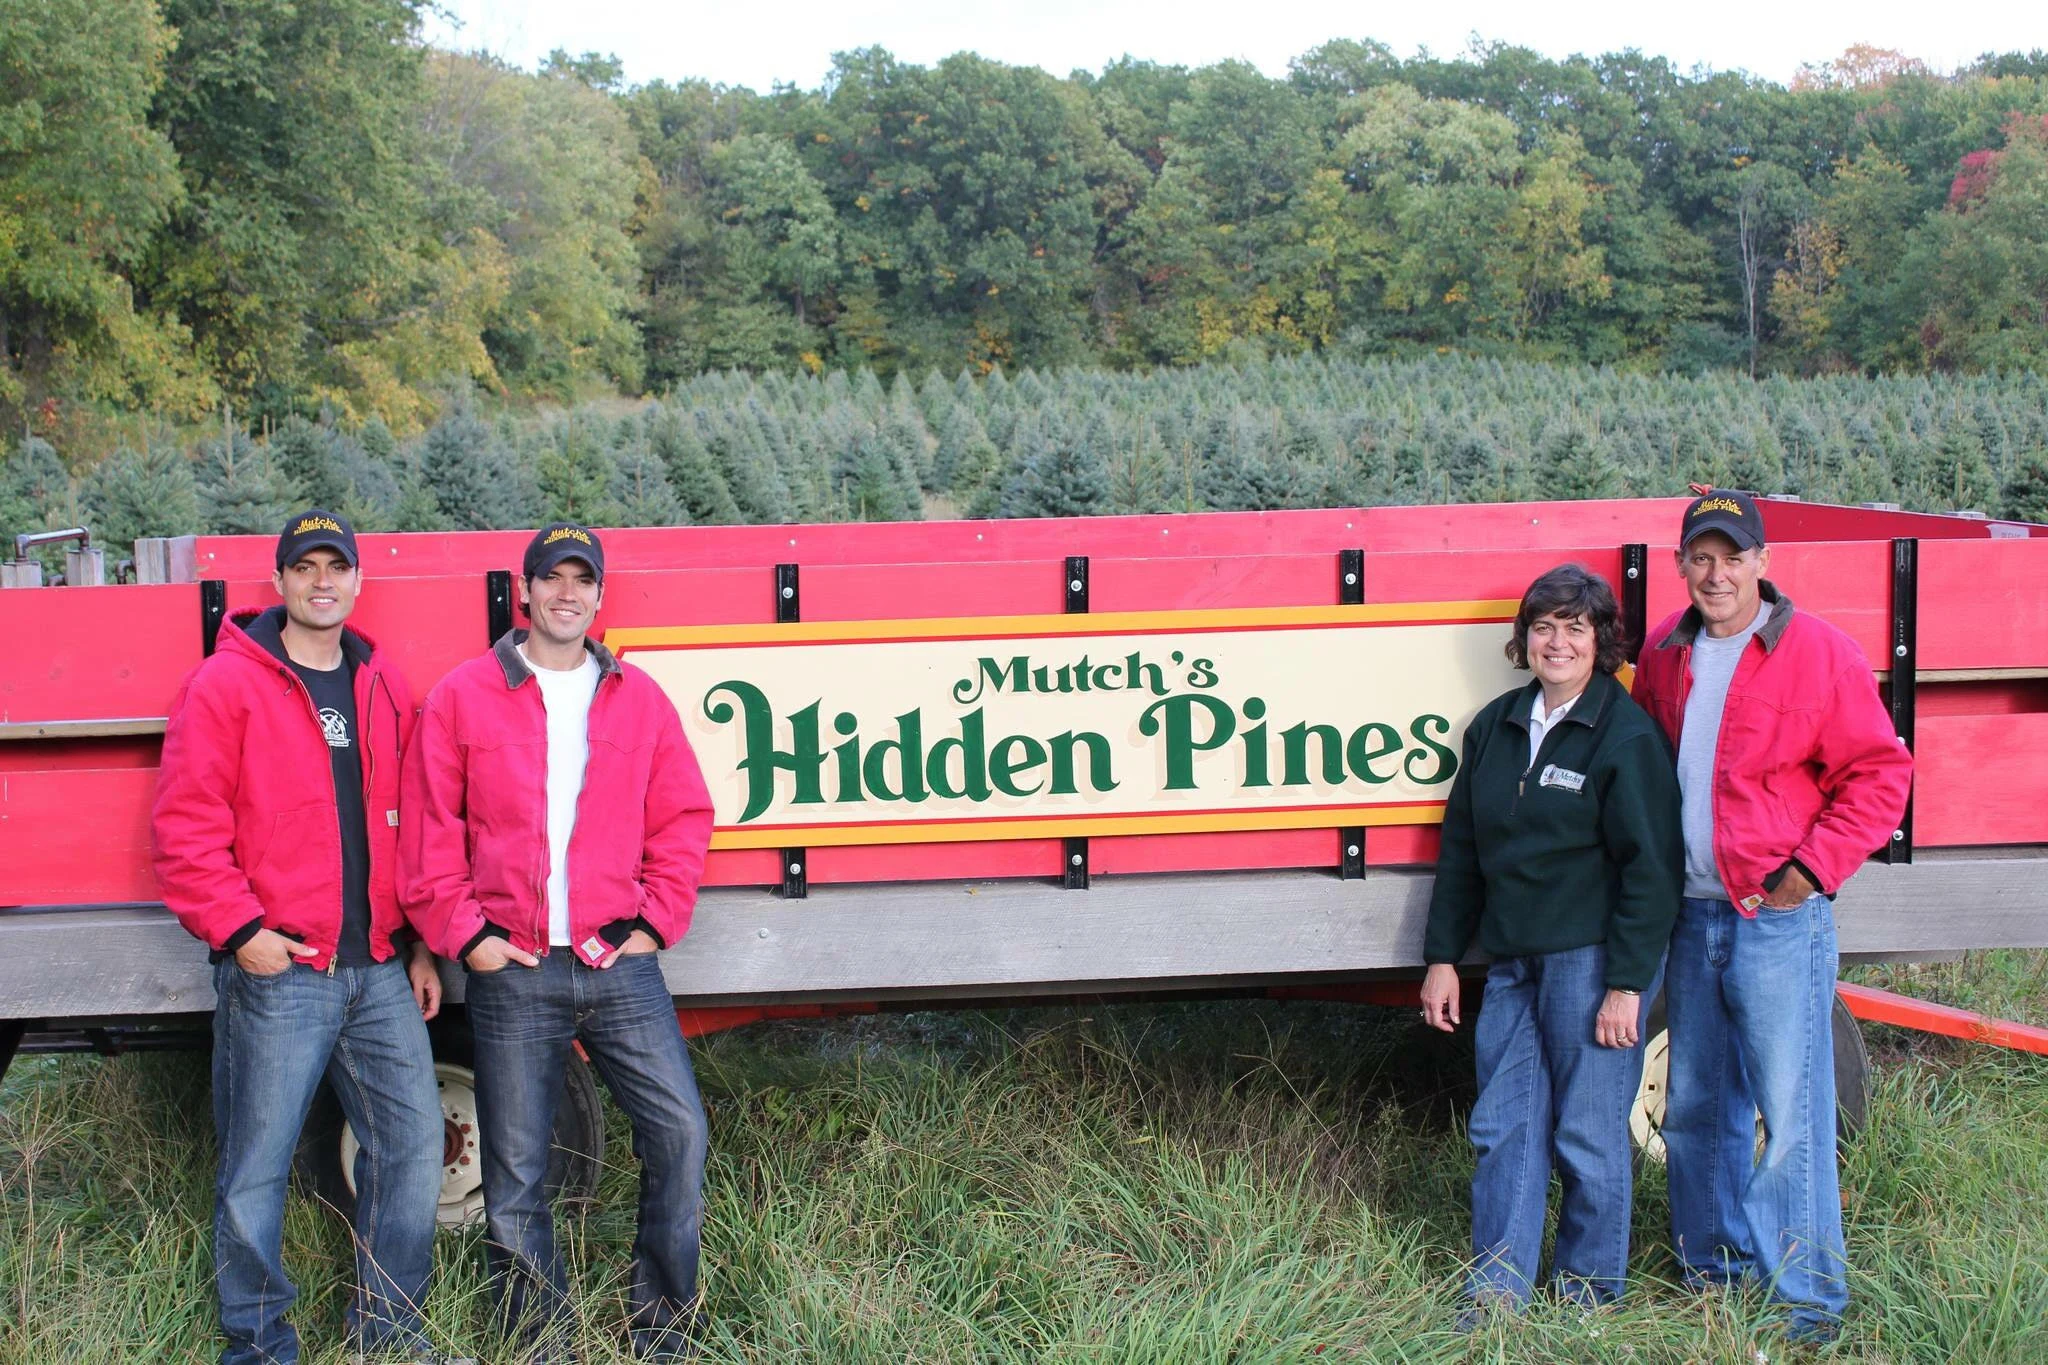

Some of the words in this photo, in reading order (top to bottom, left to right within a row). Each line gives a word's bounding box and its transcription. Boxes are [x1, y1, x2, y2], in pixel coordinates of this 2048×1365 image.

[952, 650, 1220, 705] Mutch's
[703, 679, 1122, 824] Hidden
[1139, 693, 1458, 790] Pines
